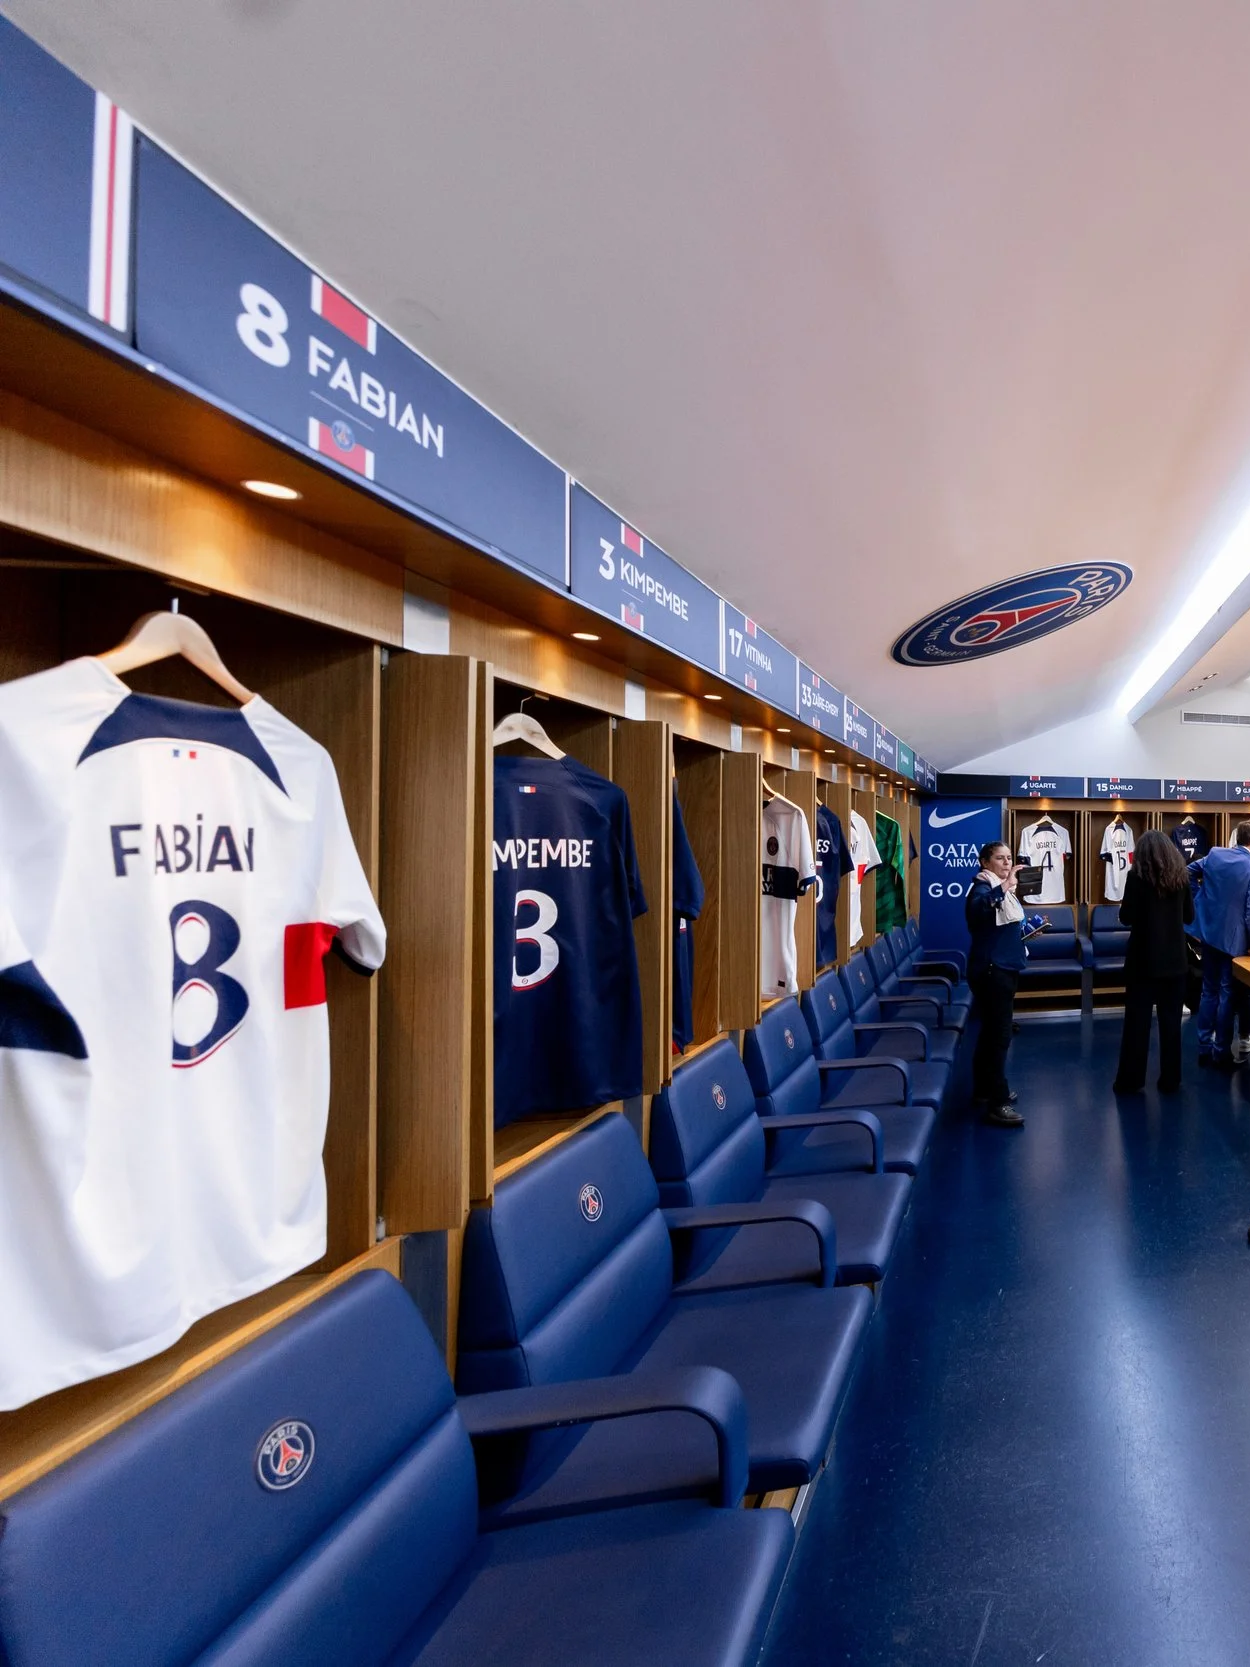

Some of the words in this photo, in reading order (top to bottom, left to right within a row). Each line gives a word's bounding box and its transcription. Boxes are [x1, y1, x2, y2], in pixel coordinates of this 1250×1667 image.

[237, 283, 290, 367] 8
[309, 335, 443, 458] FABIAN
[599, 537, 615, 580] 3
[621, 558, 688, 621] KIMPEMBE
[1064, 570, 1115, 618] PARIS
[729, 628, 743, 658] 17
[744, 641, 772, 673] VITINHA
[802, 683, 811, 707] 33
[1020, 781, 1028, 789] 4
[1096, 783, 1108, 792] 15
[1169, 785, 1176, 793] 7
[1235, 787, 1241, 795] 9
[493, 838, 593, 871] MPEMBE
[928, 843, 985, 860] QATA
[945, 858, 981, 867] AIRWA
[1041, 850, 1053, 871] 4
[1184, 847, 1194, 858] 7
[512, 889, 560, 991] 3
[262, 1423, 299, 1455] PARIS
